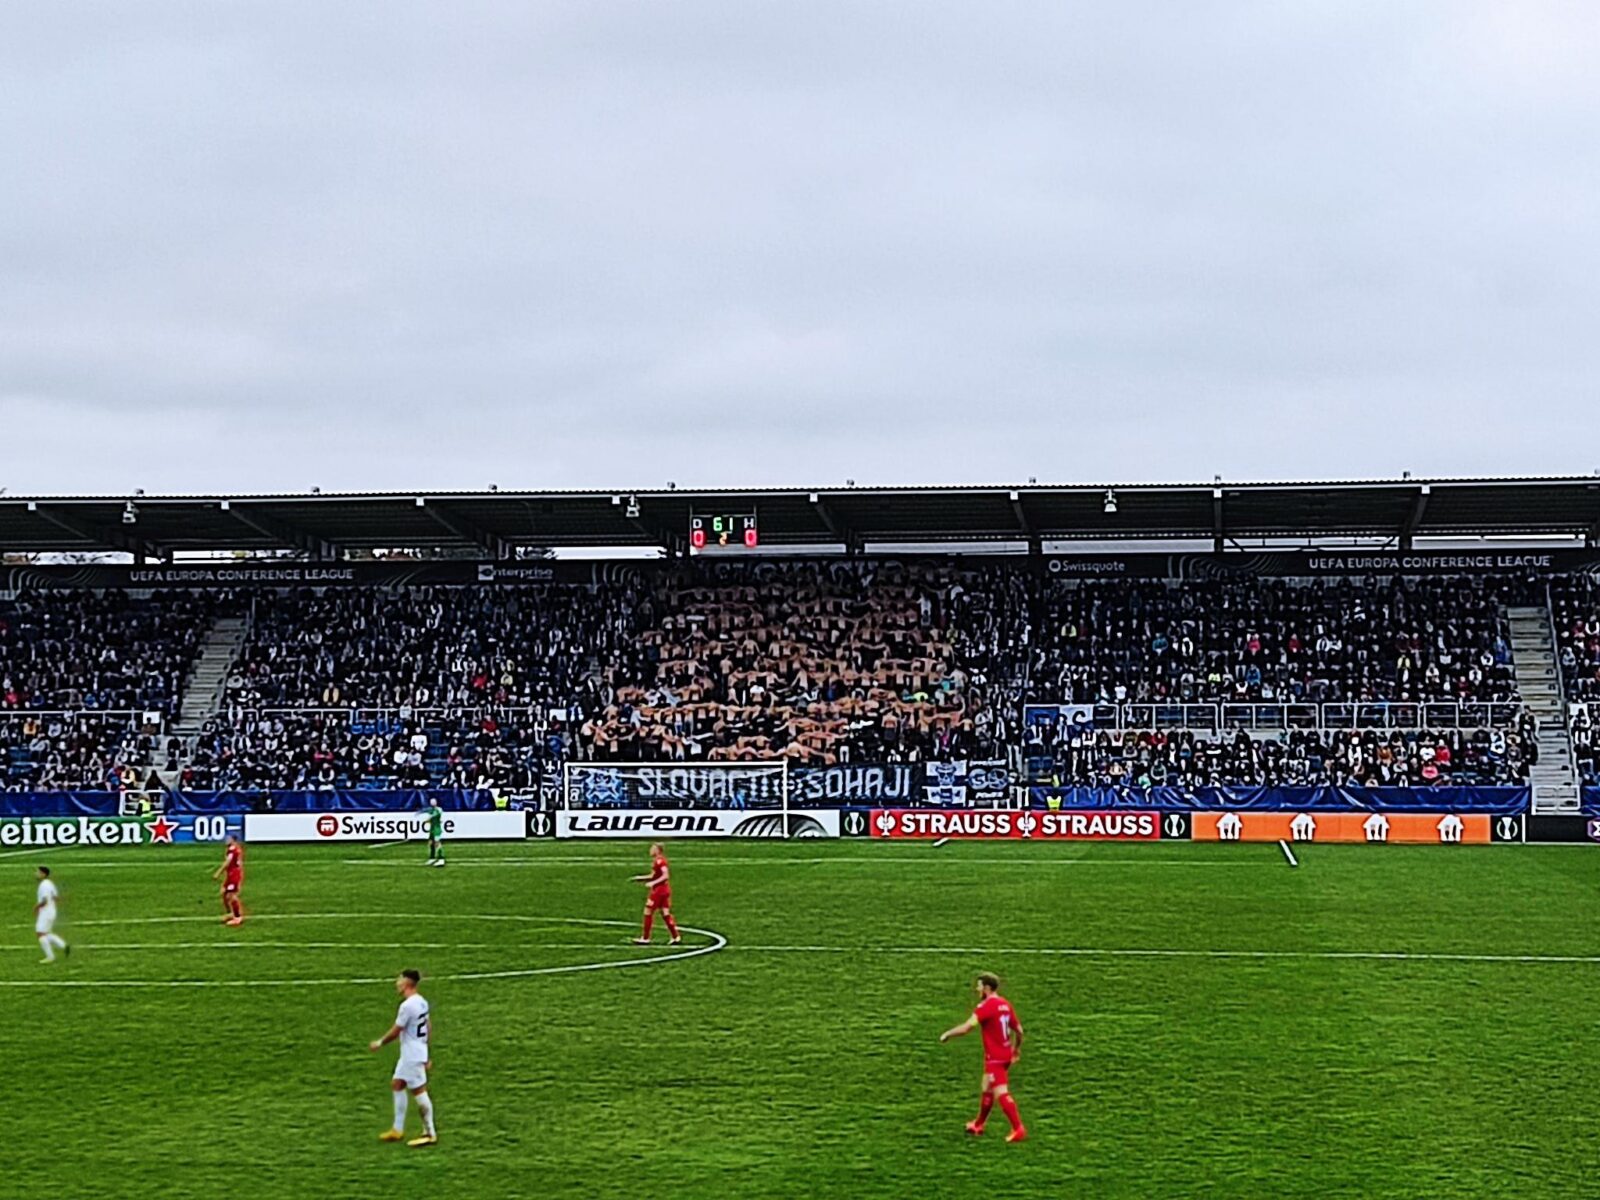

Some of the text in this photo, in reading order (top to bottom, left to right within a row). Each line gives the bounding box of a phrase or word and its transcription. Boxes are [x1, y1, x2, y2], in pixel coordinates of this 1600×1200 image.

[692, 516, 755, 532] D 61 H
[693, 529, 704, 547] 0
[745, 529, 757, 547] 0
[1062, 559, 1126, 574] Swissquote
[1309, 555, 1551, 569] UEFA EUROPA CONFERENCE LEAGUE
[130, 568, 354, 582] UEFA EUROPA CONFERENCE LEAGUE
[0, 816, 143, 845] eineken
[341, 815, 455, 840] Swissquoe
[901, 813, 1011, 834] STRAUSS
[1041, 814, 1154, 835] STRAUSS
